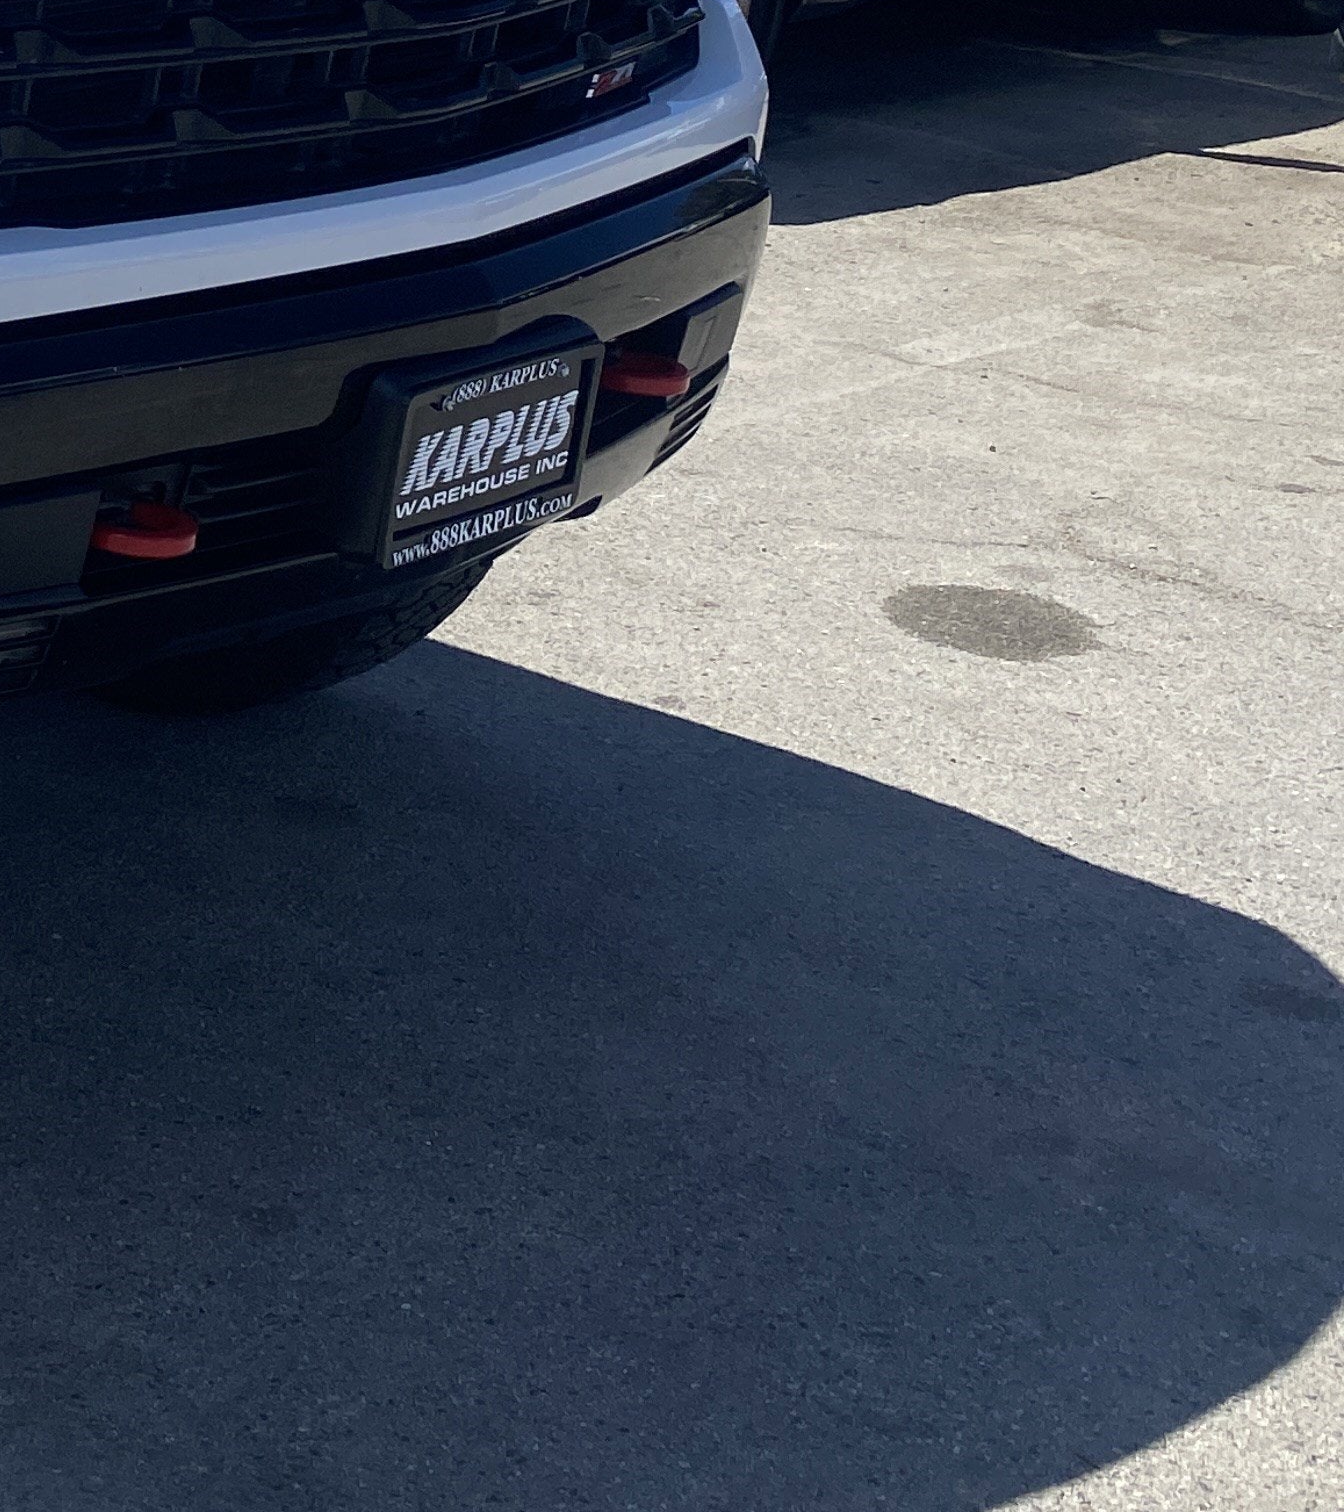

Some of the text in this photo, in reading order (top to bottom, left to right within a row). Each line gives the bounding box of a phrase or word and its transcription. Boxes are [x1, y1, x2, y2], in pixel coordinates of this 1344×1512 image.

[451, 357, 560, 404] (888) KARPLUS
[399, 390, 580, 496] KARPLUS
[395, 451, 569, 520] WAREHOUSE INC
